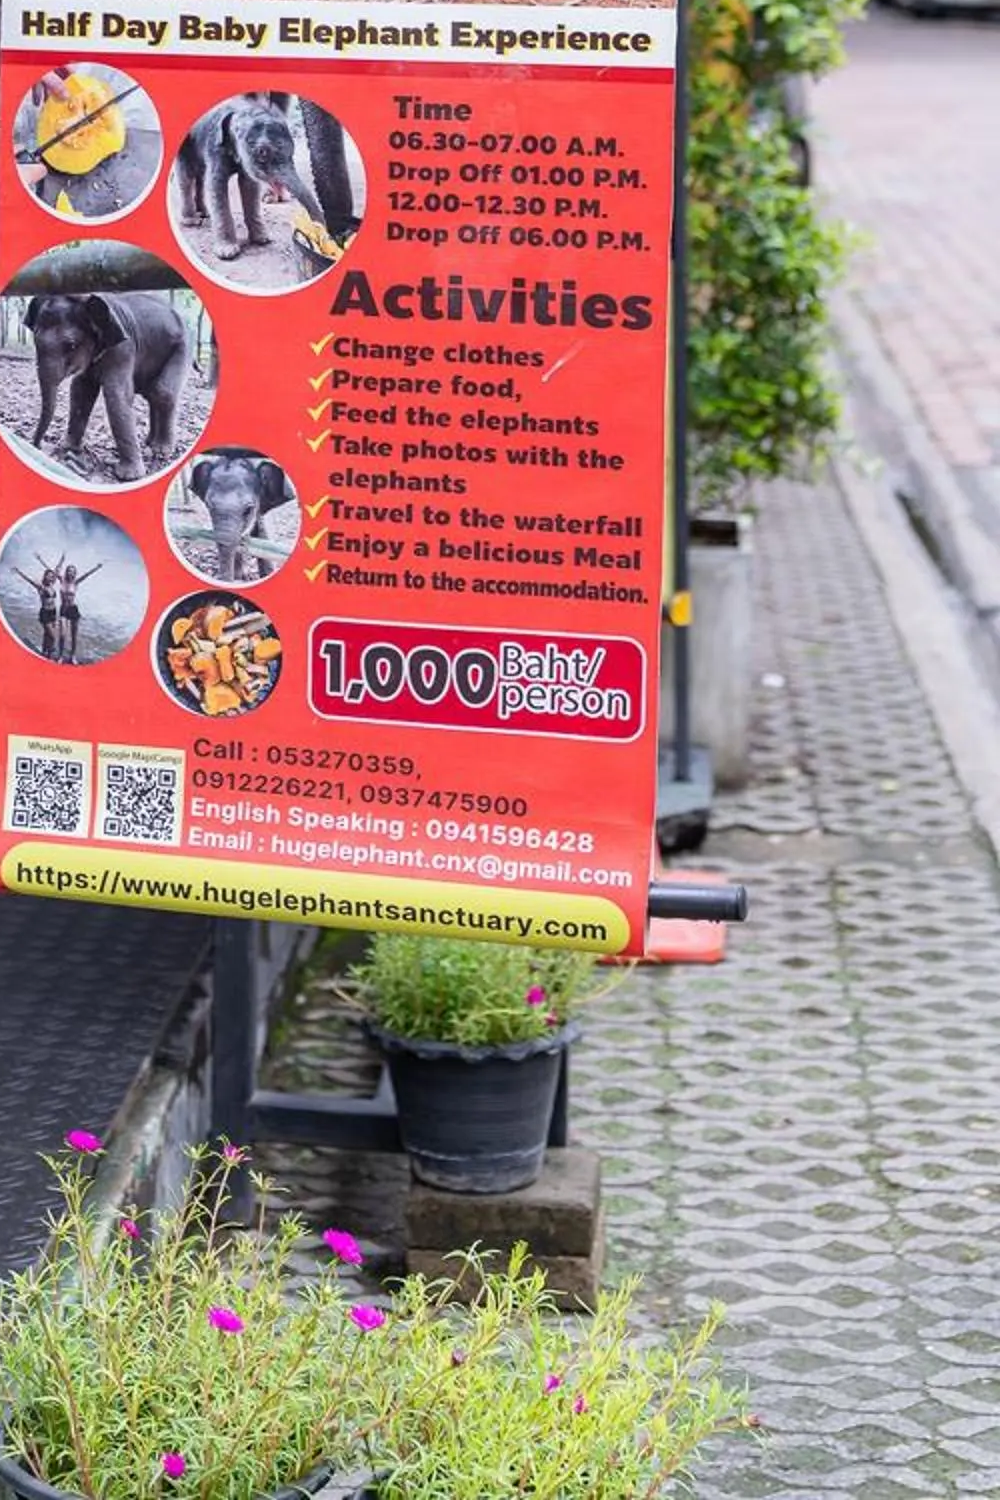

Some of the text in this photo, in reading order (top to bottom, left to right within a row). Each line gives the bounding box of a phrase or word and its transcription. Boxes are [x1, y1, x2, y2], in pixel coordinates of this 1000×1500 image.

[21, 10, 652, 55] Half Day Baby Elephant Experience
[393, 95, 473, 122] Time
[388, 130, 625, 158] 06.30-07.00 A.M.
[388, 161, 648, 190] Drop Off 01.00 P.M.
[387, 191, 609, 219] 12.00-12.30 P.M.
[386, 222, 651, 252] Drop Off 06.00 P.M.
[330, 270, 653, 331] Activities
[332, 336, 545, 368] Change clothes
[331, 369, 523, 402] Prepare food,
[330, 402, 600, 438] Feed the elephants
[329, 435, 625, 471] Take photos with the
[328, 468, 468, 496] elephants
[327, 499, 644, 538] Travel to the waterfall
[326, 531, 642, 571] Enjoy a belicious Meal
[326, 563, 650, 605] Return to the accommodation.
[319, 639, 499, 708] 1,000
[498, 680, 632, 720] person
[27, 740, 74, 755] WhatsApp
[193, 738, 244, 761] Call
[266, 744, 422, 780] 053270359,
[191, 769, 528, 817] 0912226221, 0937475900
[190, 797, 281, 825] English
[287, 806, 405, 841] Speaking
[425, 818, 595, 853] 0941596428
[187, 825, 253, 851] Email
[271, 835, 633, 888] hugelephant.cnx@gmail.com
[16, 861, 608, 941] https://www.hugelephantsanctuary.com
